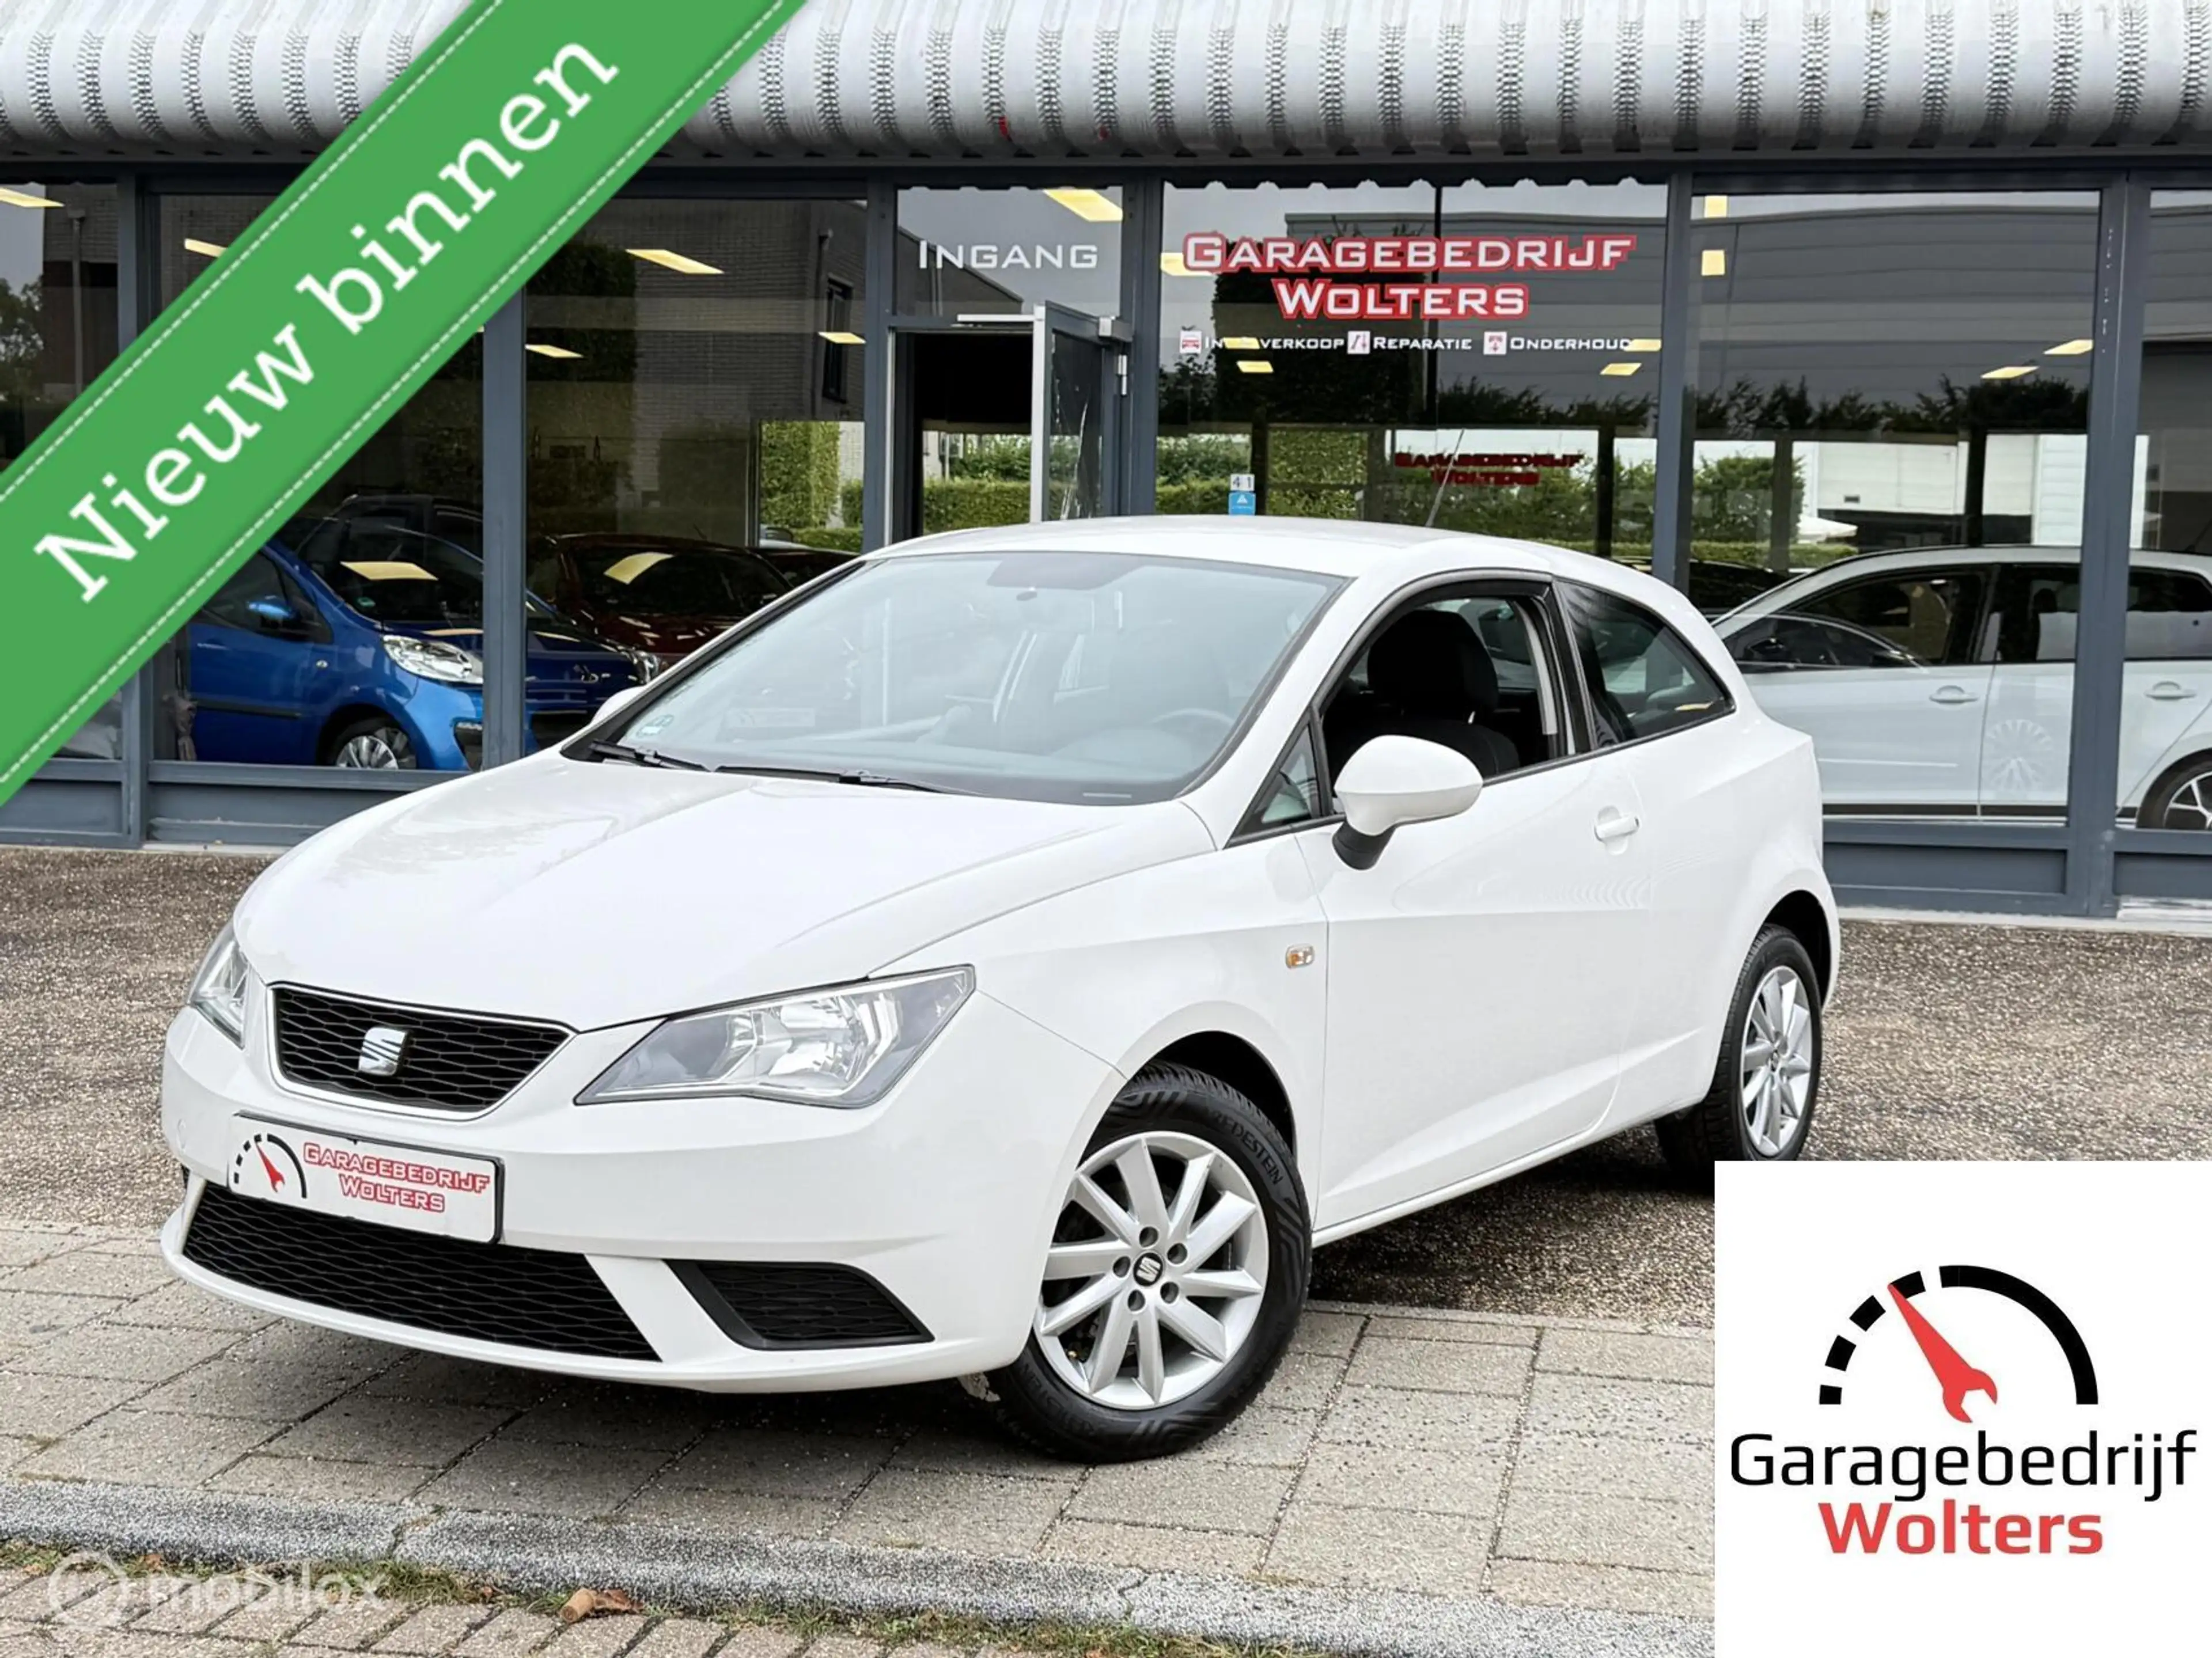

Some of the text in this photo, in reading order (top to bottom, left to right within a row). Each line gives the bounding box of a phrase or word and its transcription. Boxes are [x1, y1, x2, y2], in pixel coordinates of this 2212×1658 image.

[919, 240, 1098, 269] INGANG
[1183, 233, 1637, 272] GARAGEBEDRIJF
[1272, 279, 1529, 319] WOLTERS
[1372, 336, 1472, 350] REPARATIE
[1232, 476, 1252, 488] 41
[304, 1142, 490, 1193] GARAGEBEDRIJF
[339, 1173, 445, 1212] WOLTERS
